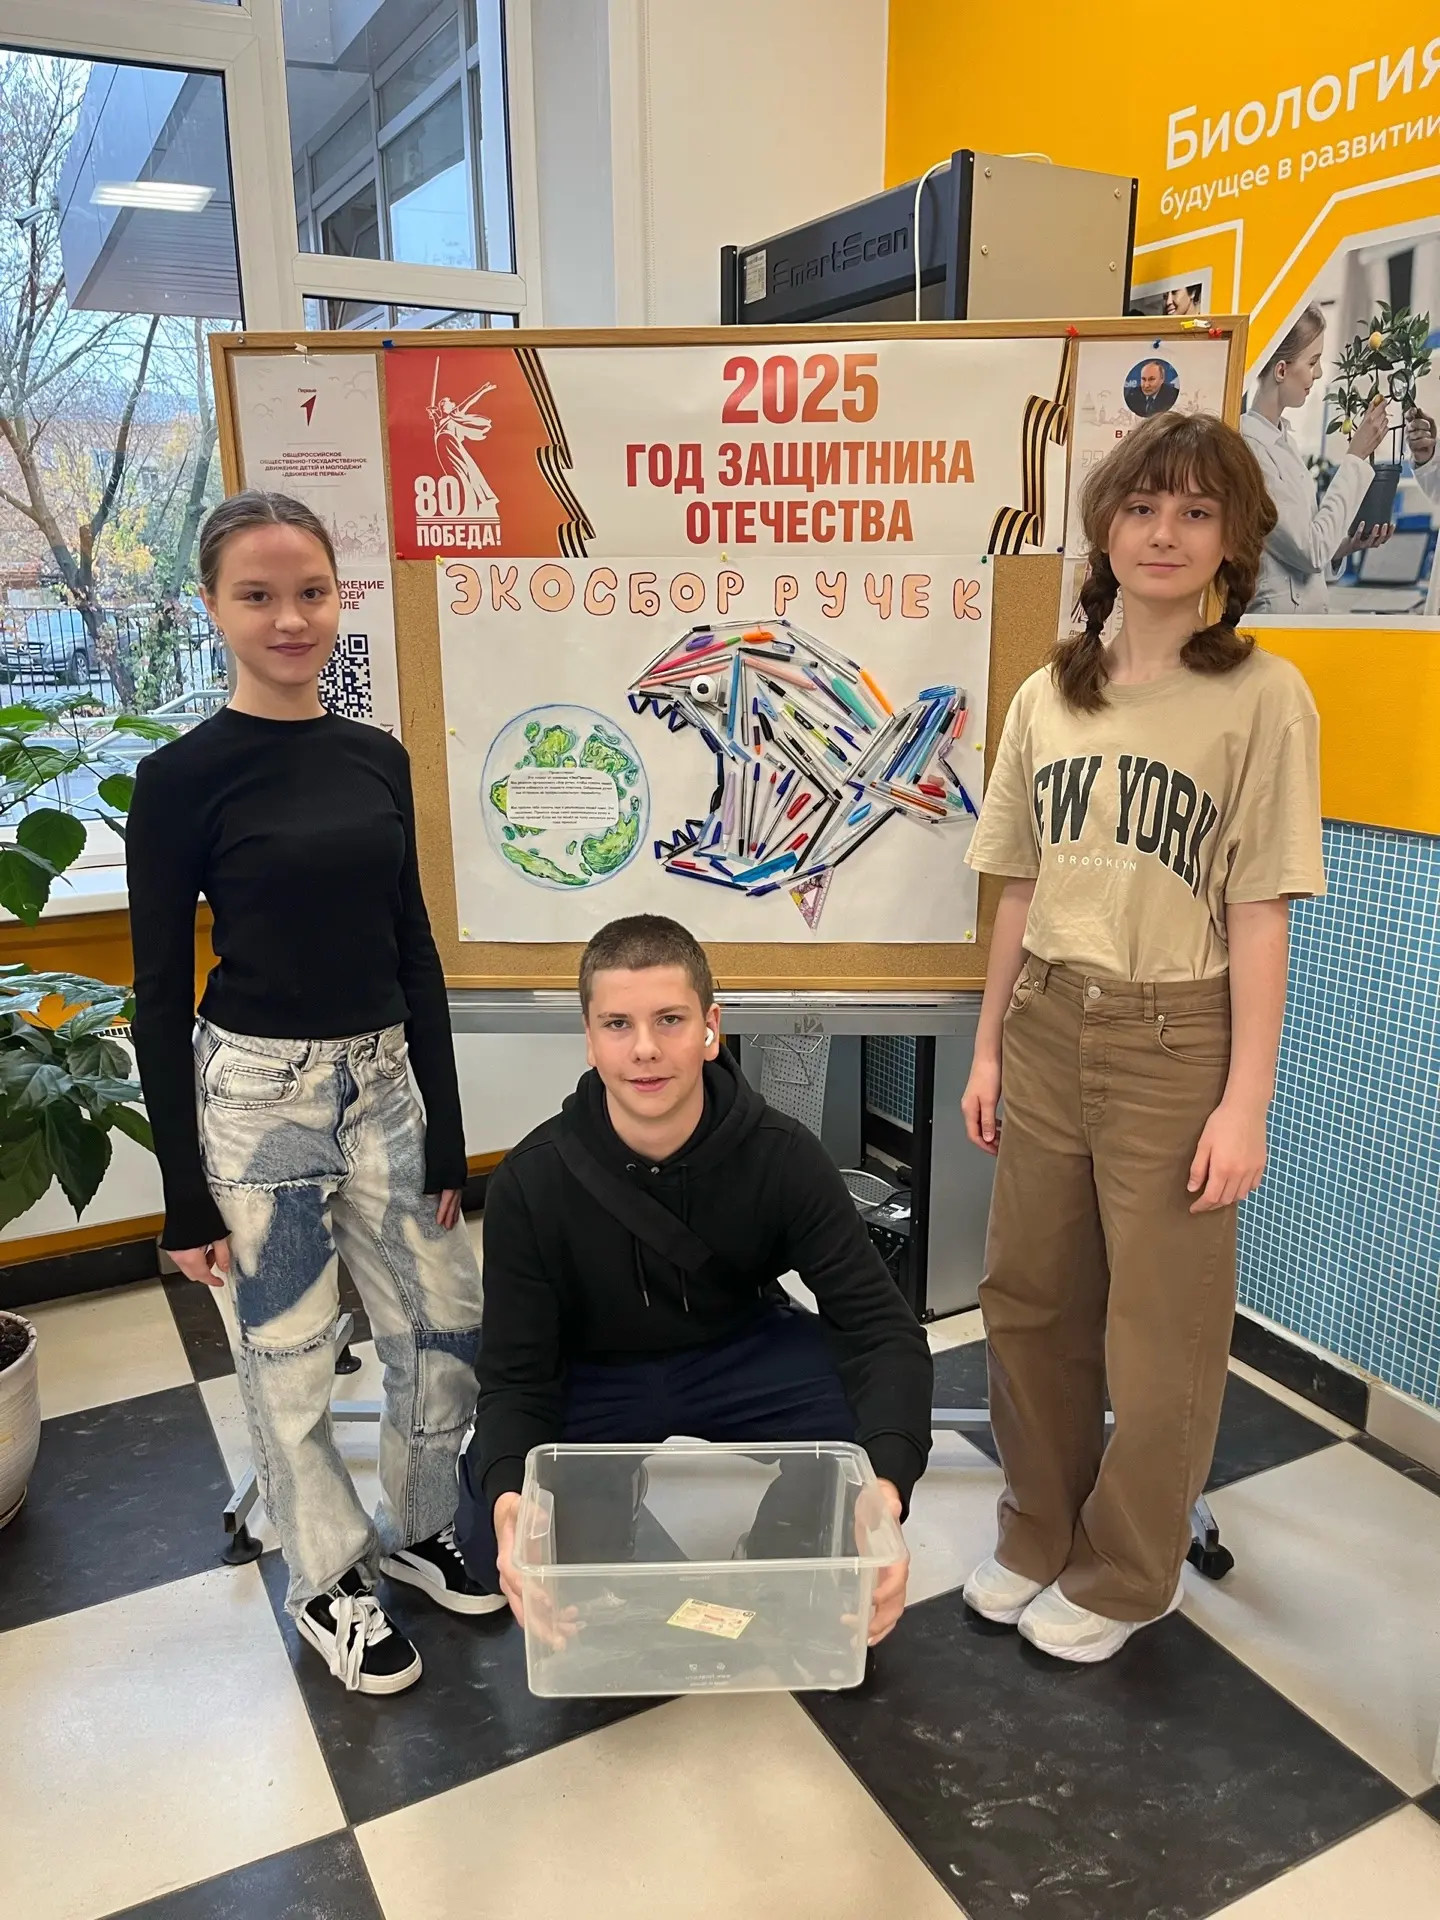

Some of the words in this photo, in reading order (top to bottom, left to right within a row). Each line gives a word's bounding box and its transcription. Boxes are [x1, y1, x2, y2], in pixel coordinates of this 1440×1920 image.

[1165, 36, 1440, 171] Биология
[1160, 164, 1270, 220] будущее
[1277, 156, 1292, 181] в
[721, 353, 879, 424] 2025
[626, 443, 705, 494] ГОД
[718, 440, 975, 492] ЗАЩИТНИКА
[414, 475, 464, 518] 80
[416, 524, 502, 549] ПОБЕДА!
[686, 500, 914, 545] ОТЕЧЕСТВА
[338, 580, 385, 590] ЖЕНИЕ
[339, 588, 365, 600] ОЕЙ
[445, 563, 745, 617] ЭКОСБОР
[774, 570, 982, 620] РУЧЕК
[1033, 755, 1104, 864] EW
[1115, 754, 1219, 900] YORK
[1057, 854, 1138, 872] BROOKLYN
